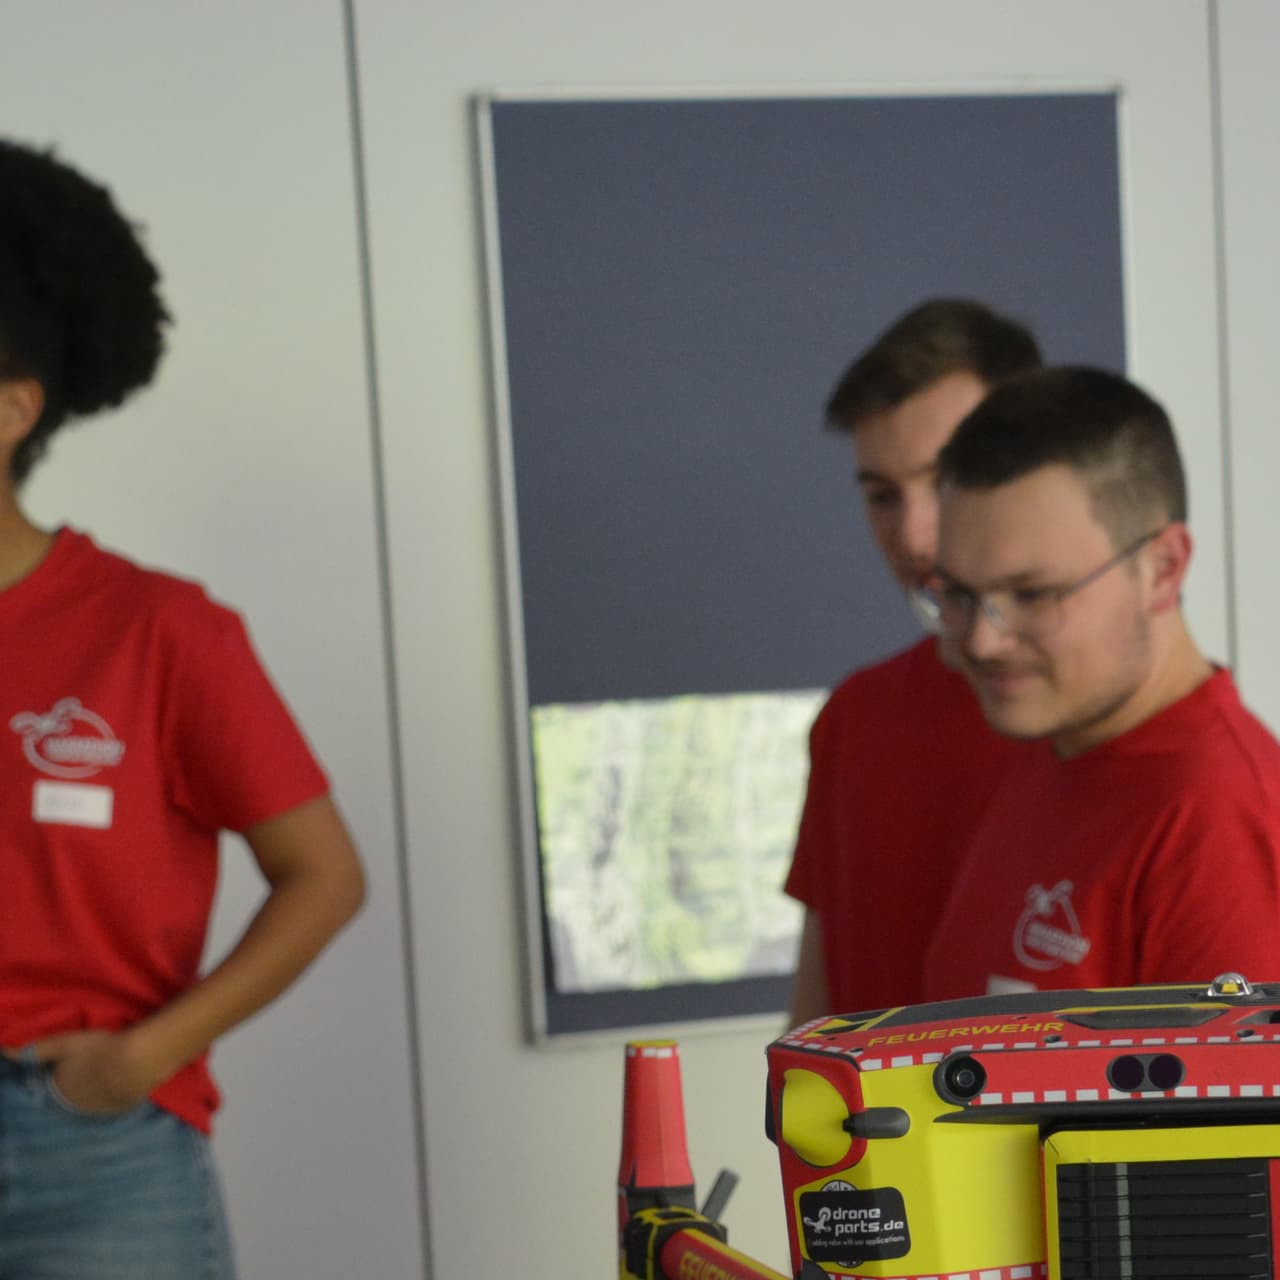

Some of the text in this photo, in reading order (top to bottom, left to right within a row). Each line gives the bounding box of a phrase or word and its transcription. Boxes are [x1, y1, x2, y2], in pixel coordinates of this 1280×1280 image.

[867, 1022, 1065, 1047] FEUERWEHR
[833, 1208, 881, 1220] drone
[835, 1220, 904, 1237] parts.de
